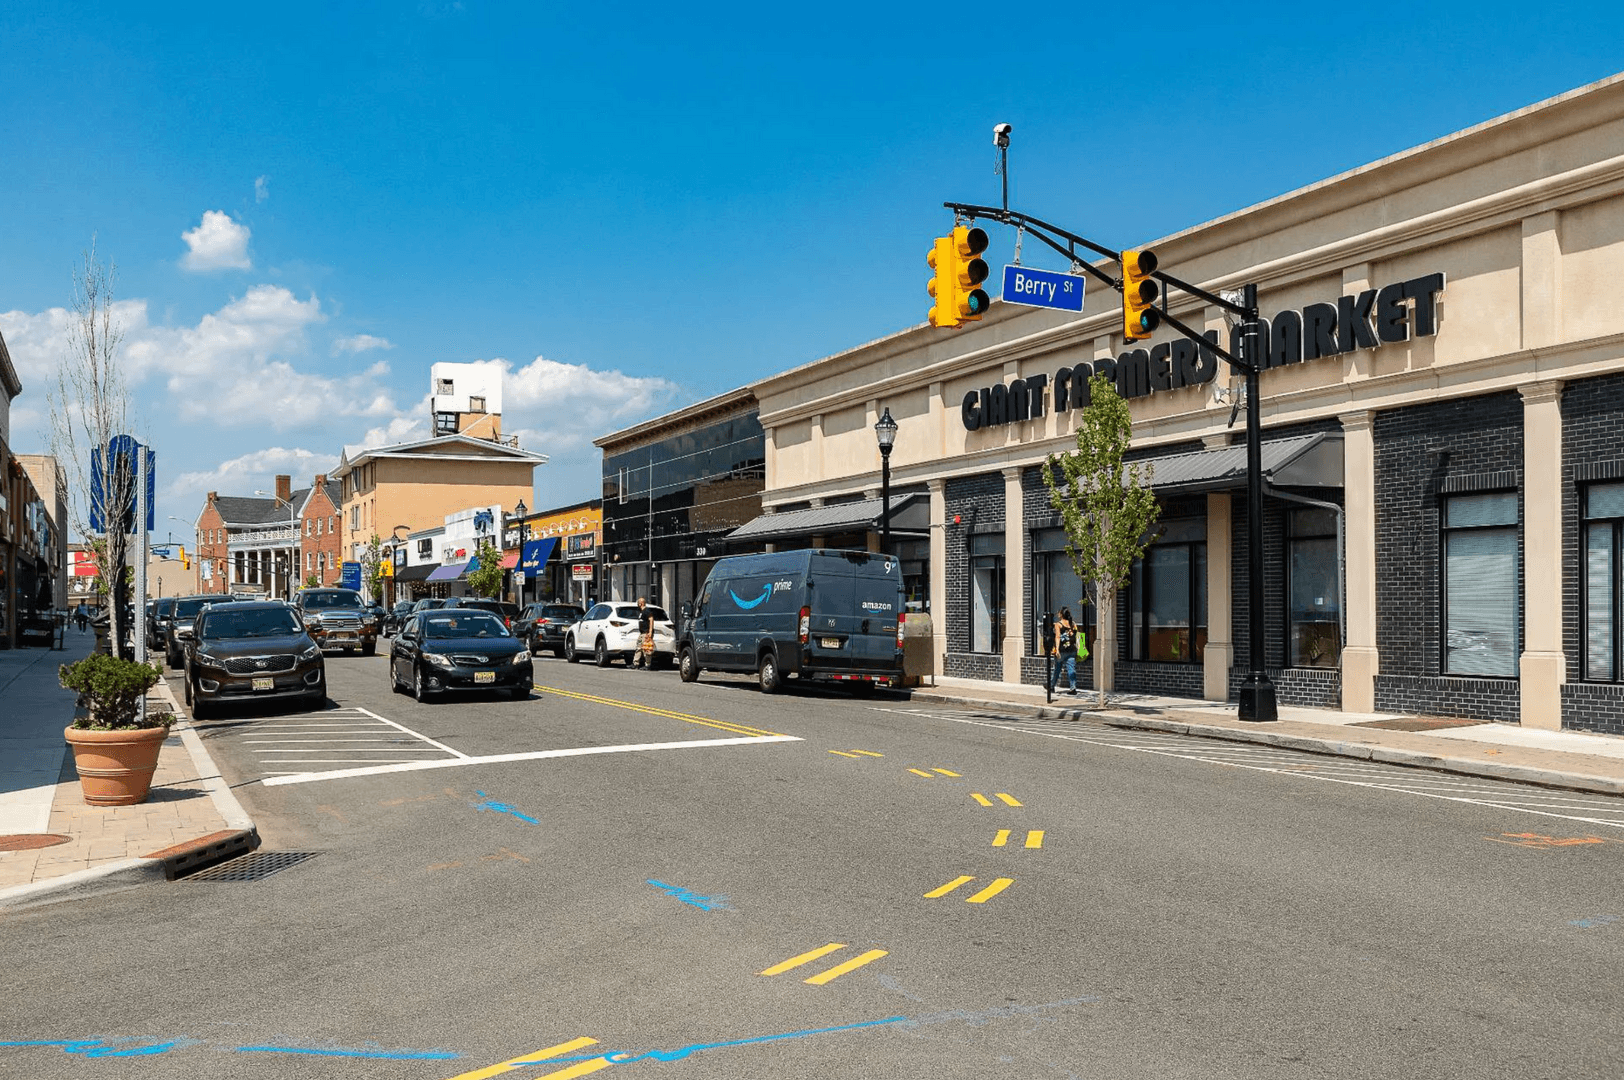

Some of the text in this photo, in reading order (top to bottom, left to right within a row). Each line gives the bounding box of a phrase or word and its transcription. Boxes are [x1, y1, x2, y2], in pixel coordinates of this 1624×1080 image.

[1015, 273, 1074, 302] Berry St
[961, 373, 1050, 431] GIANT
[773, 578, 792, 595] prime
[861, 601, 892, 610] amazon
